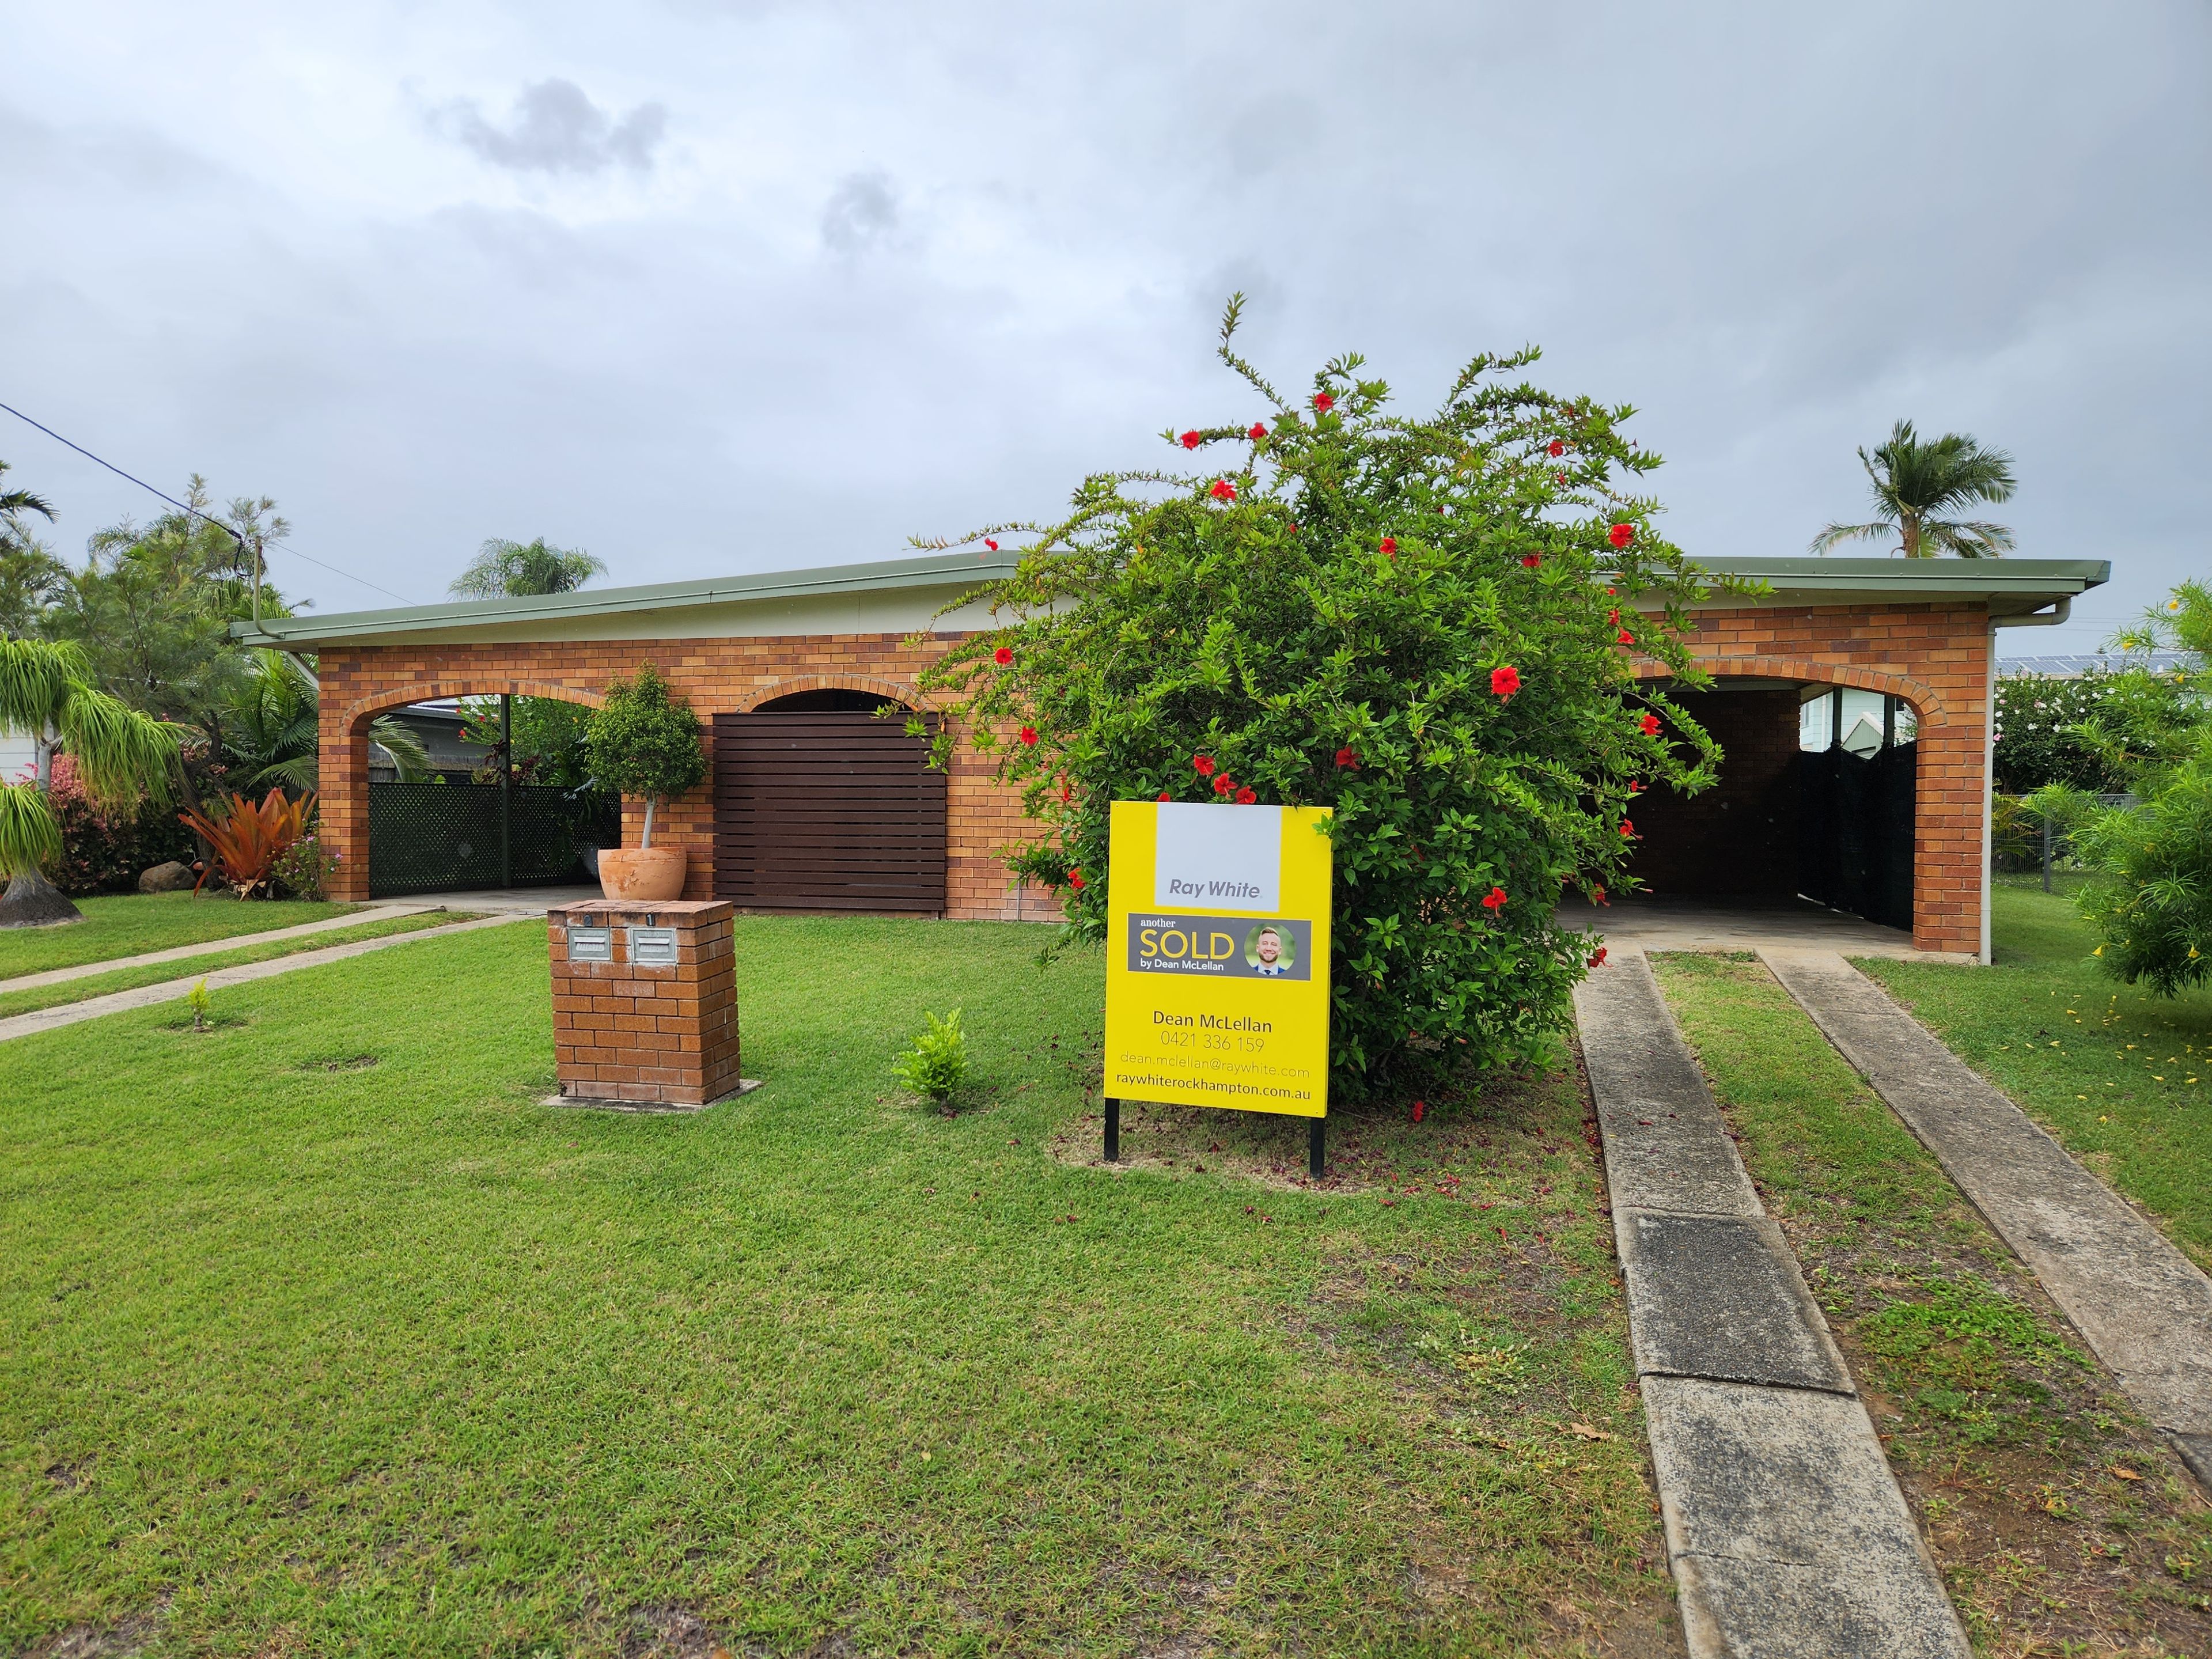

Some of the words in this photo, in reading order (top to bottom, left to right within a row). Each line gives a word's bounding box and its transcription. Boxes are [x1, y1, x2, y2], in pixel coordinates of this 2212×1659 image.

[1169, 879, 1205, 898] Ray
[1209, 881, 1260, 899] White
[646, 914, 653, 926] 1
[1140, 918, 1176, 928] another
[1139, 929, 1234, 960] SOLD
[1140, 958, 1152, 968] by
[1154, 959, 1179, 968] Dean
[1181, 961, 1224, 971] McLellan
[1153, 1010, 1194, 1027] Dean
[1200, 1014, 1272, 1033] McLellan
[1161, 1031, 1196, 1047] 0421
[1203, 1035, 1231, 1050] 336
[1237, 1037, 1265, 1053] 159
[1120, 1050, 1310, 1079] dean.mclellan@raywhite.com
[1116, 1073, 1310, 1100] raywhiterockhampton.com.au
